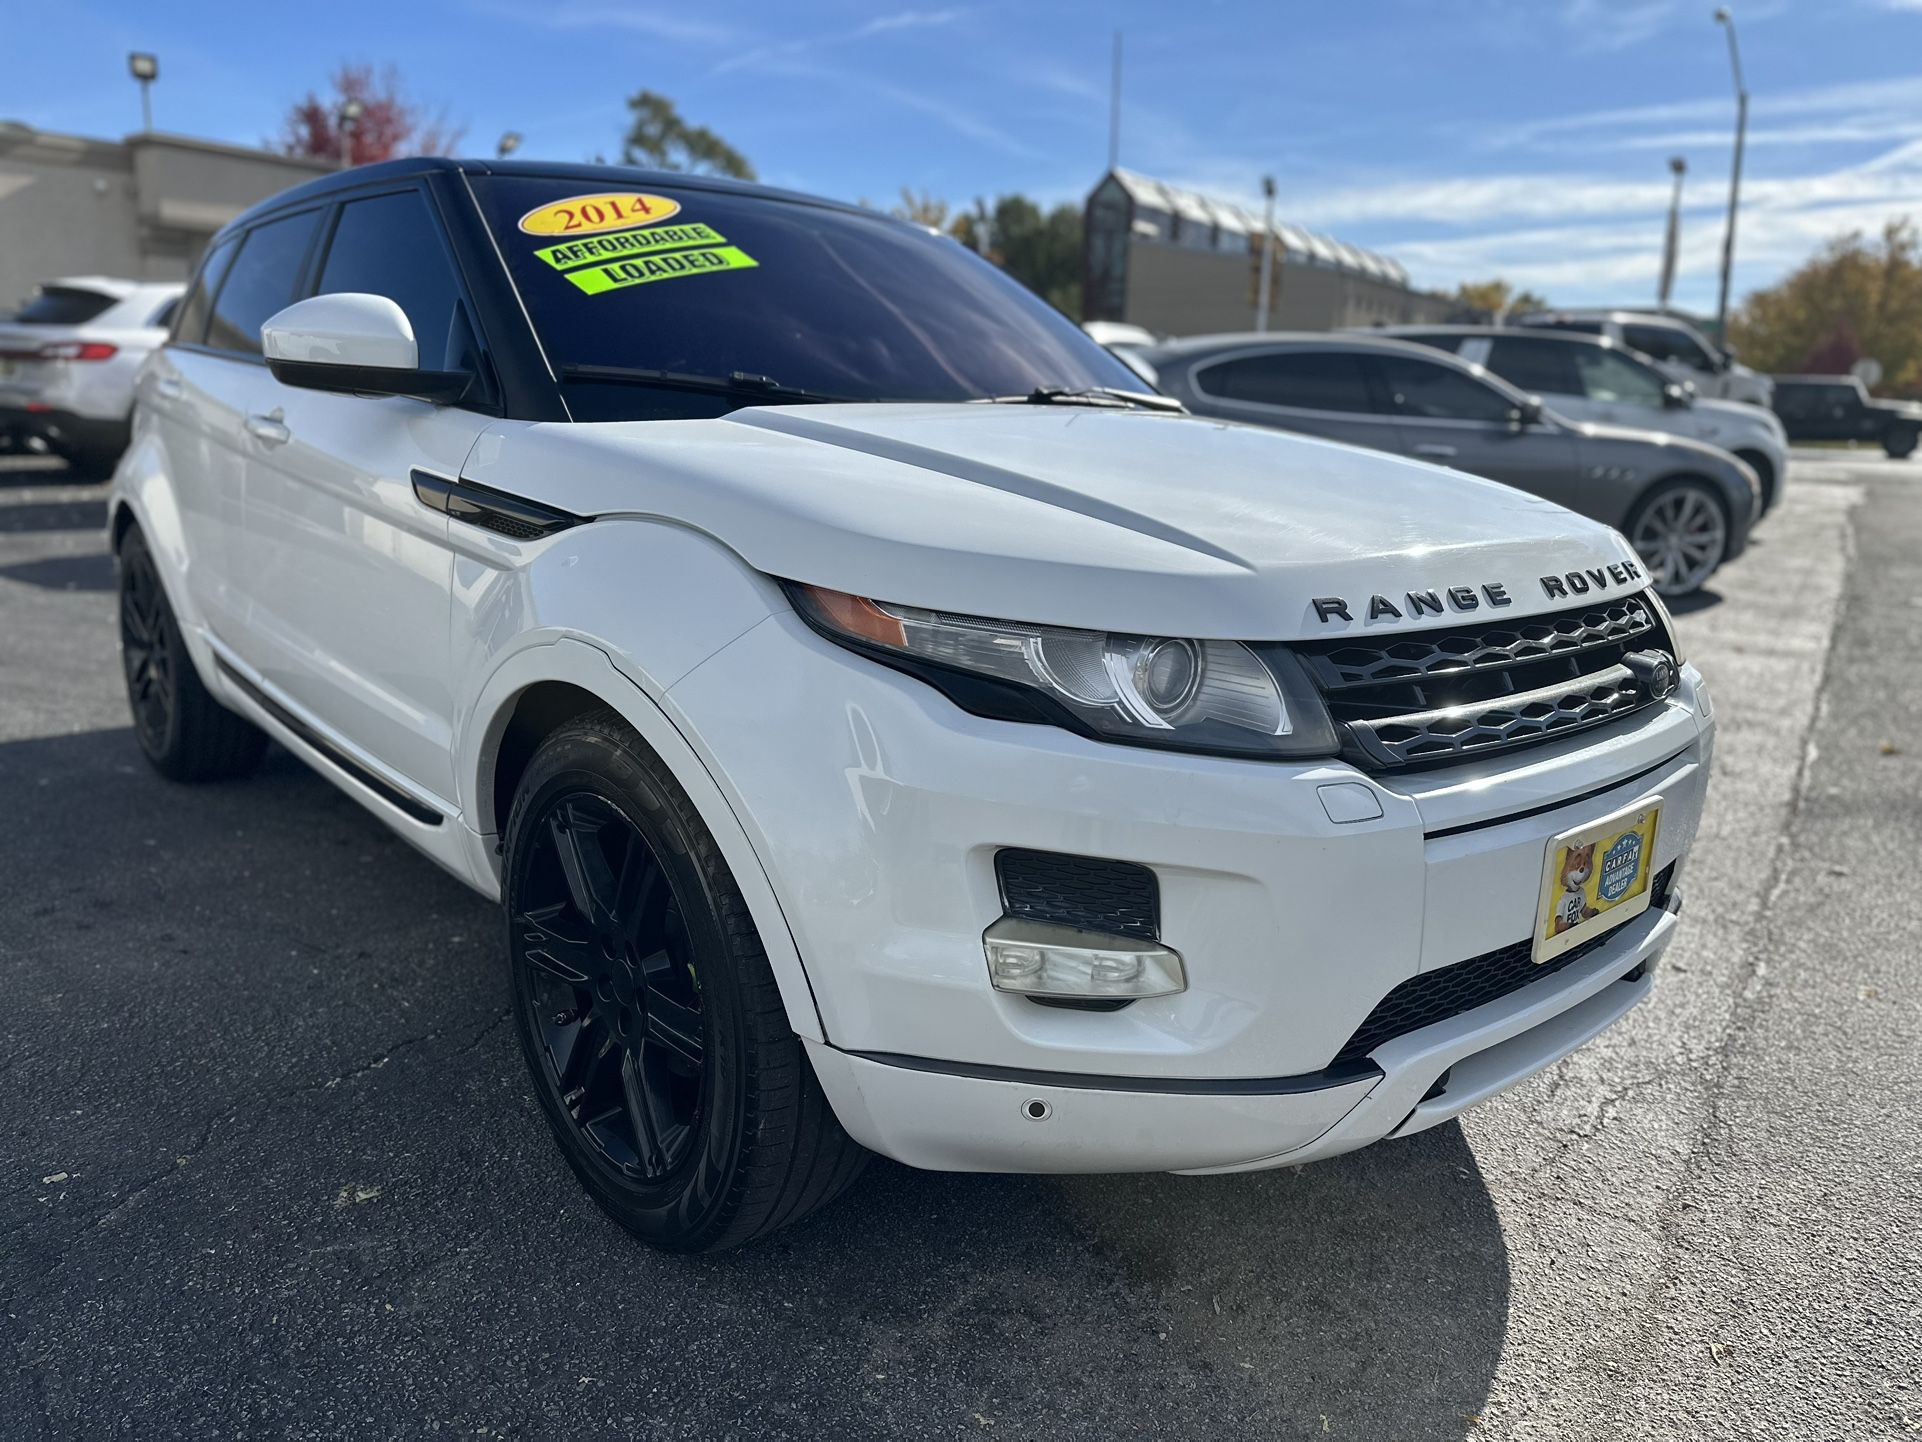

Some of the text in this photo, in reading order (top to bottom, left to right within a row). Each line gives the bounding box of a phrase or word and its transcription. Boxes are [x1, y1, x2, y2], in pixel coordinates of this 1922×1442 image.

[553, 196, 653, 232] 2014
[550, 226, 717, 266] AFFORDABLE
[601, 251, 730, 285] LOADED
[1311, 560, 1642, 623] RANGE ROVER
[1567, 896, 1582, 913] CAR
[1607, 878, 1628, 897] DEALER
